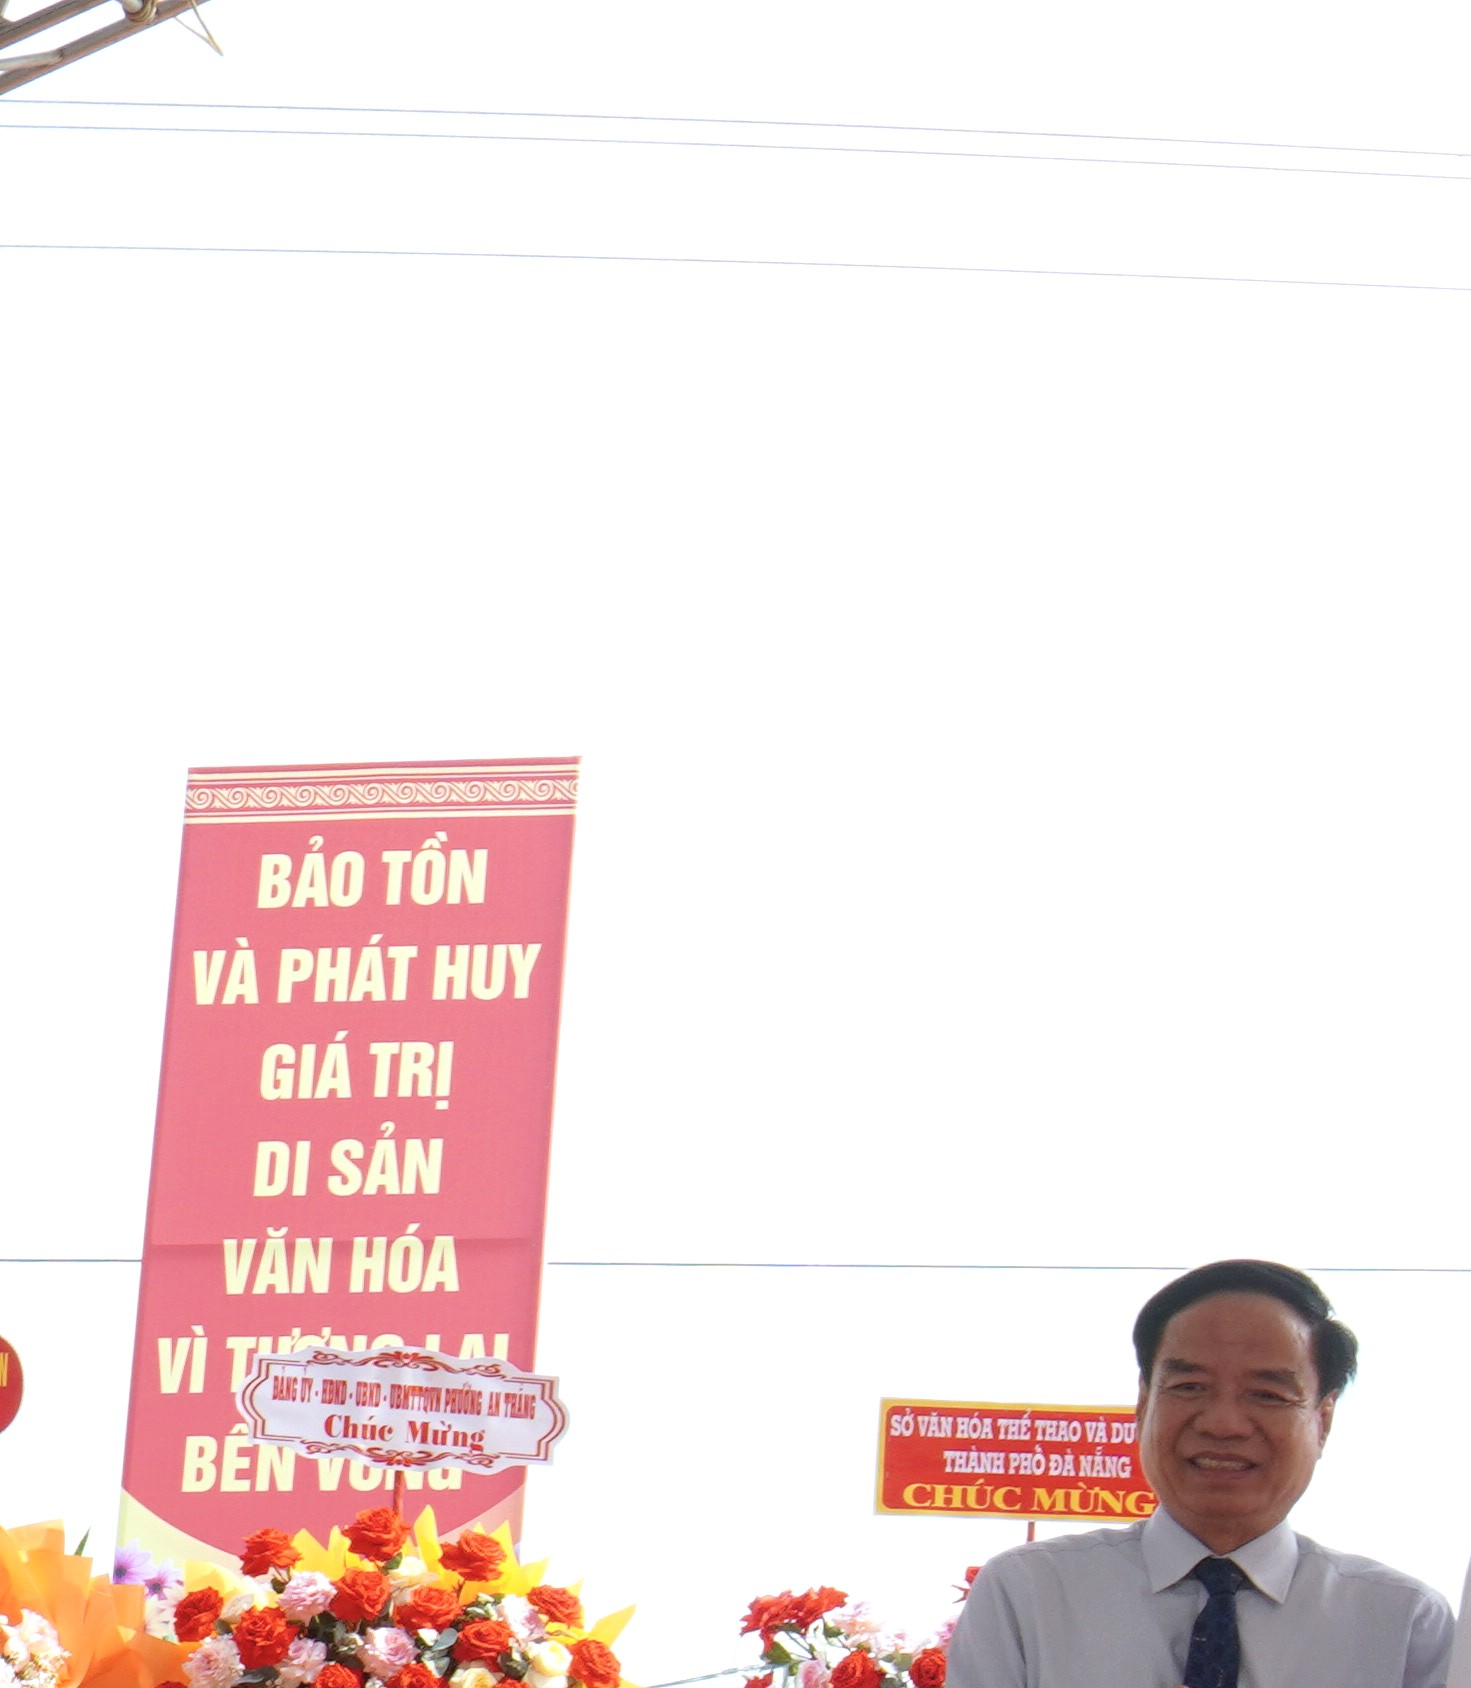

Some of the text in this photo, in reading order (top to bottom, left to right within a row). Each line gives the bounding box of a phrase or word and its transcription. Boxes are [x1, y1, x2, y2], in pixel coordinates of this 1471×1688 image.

[257, 831, 488, 908] BẢO TỒN
[193, 934, 542, 1005] VÀ PHÁT HUY
[260, 1031, 454, 1110] GIÁ TRỊ
[253, 1121, 443, 1196] DI SẢN
[223, 1223, 459, 1294] VĂN HÓA
[157, 1325, 208, 1394] VÌ
[325, 1414, 485, 1453] Chúc Mừng
[487, 1392, 500, 1416] AN
[890, 1408, 1136, 1444] SỞ VĂN HÓA THỂ THAO VÀ DU
[943, 1445, 1005, 1474] THÀNH
[1008, 1444, 1045, 1476] PHỐ
[1049, 1449, 1076, 1477] ĐÀ
[903, 1479, 1156, 1515] CHÚC MỪNG
